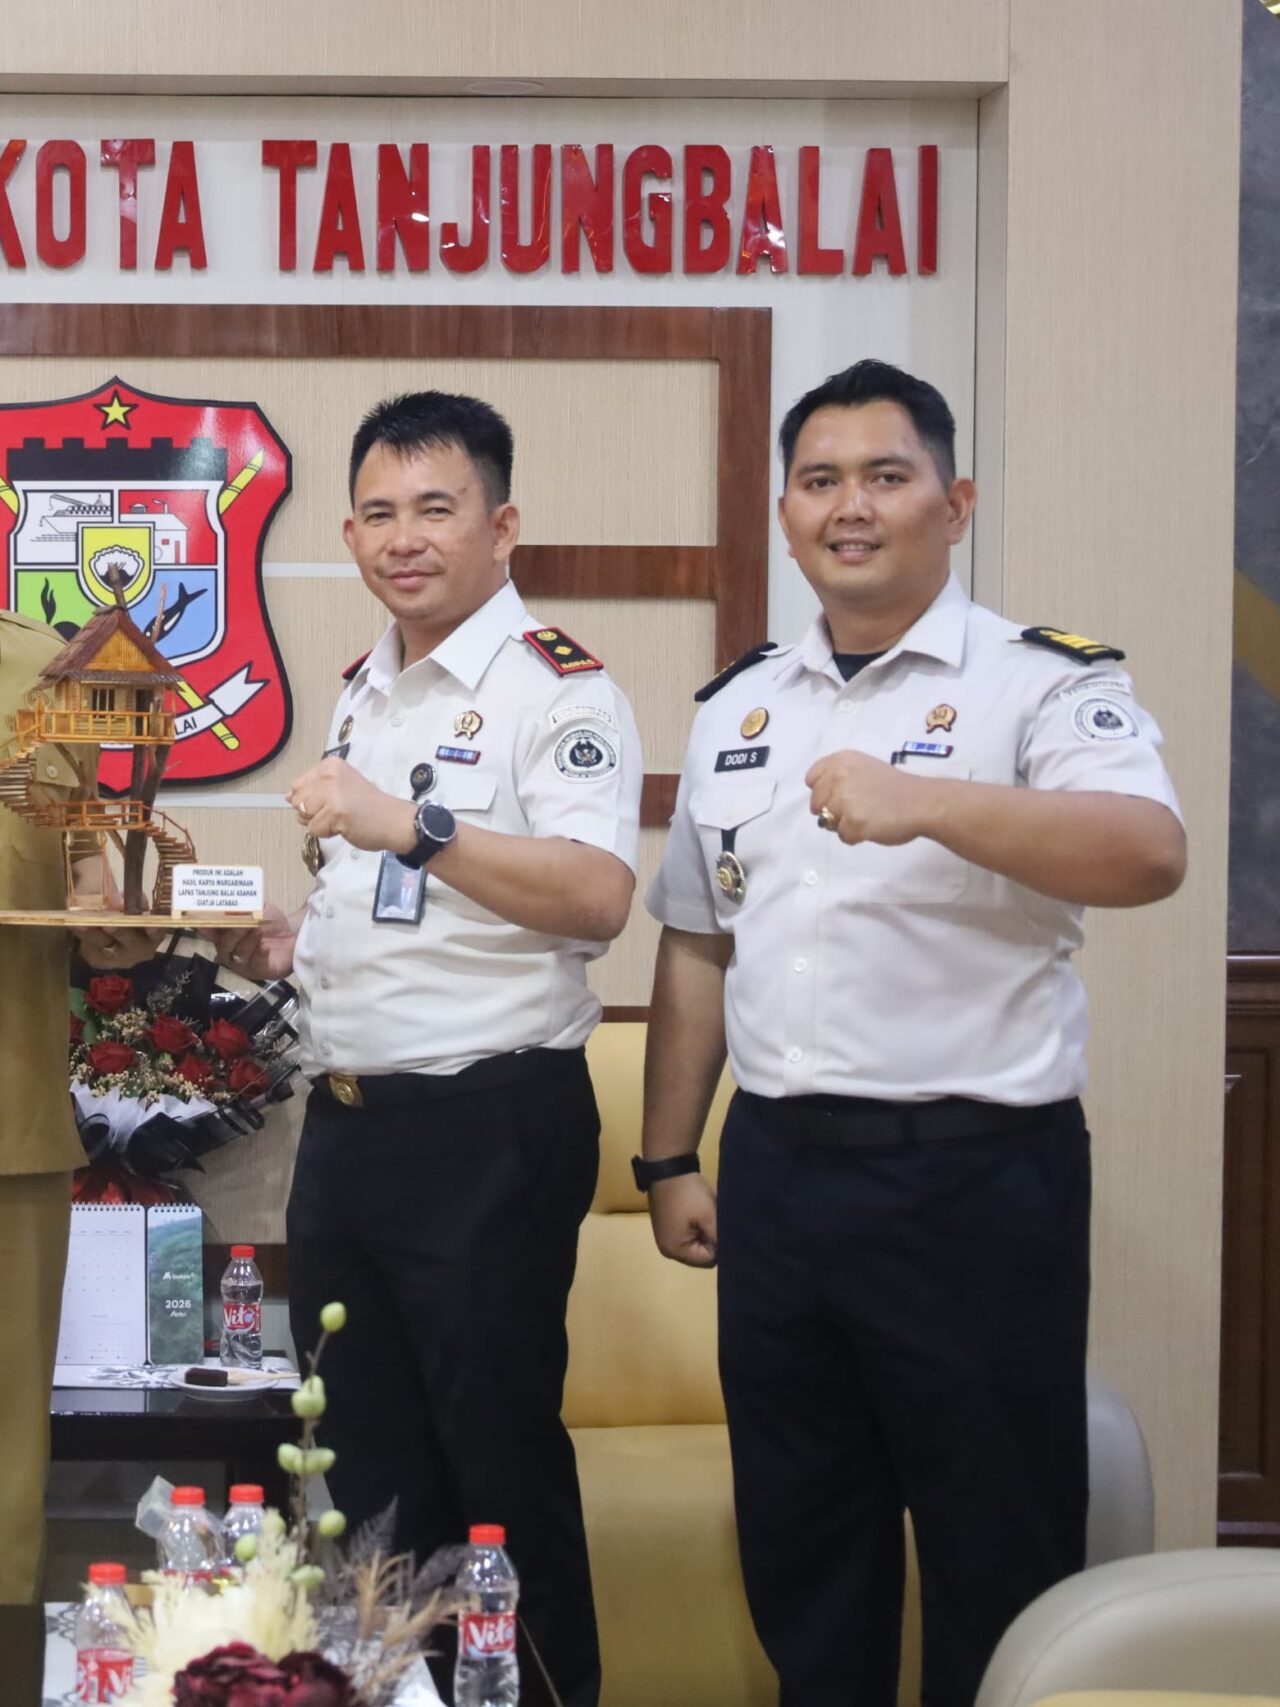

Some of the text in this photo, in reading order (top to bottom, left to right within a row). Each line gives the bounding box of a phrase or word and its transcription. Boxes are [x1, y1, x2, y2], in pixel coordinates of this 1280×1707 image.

[262, 139, 938, 275] TANJUNGBALAI
[173, 716, 198, 736] LAI
[724, 751, 758, 766] DODI S
[192, 868, 244, 877] PRODUK INI ADALAH
[165, 1299, 191, 1309] 2026
